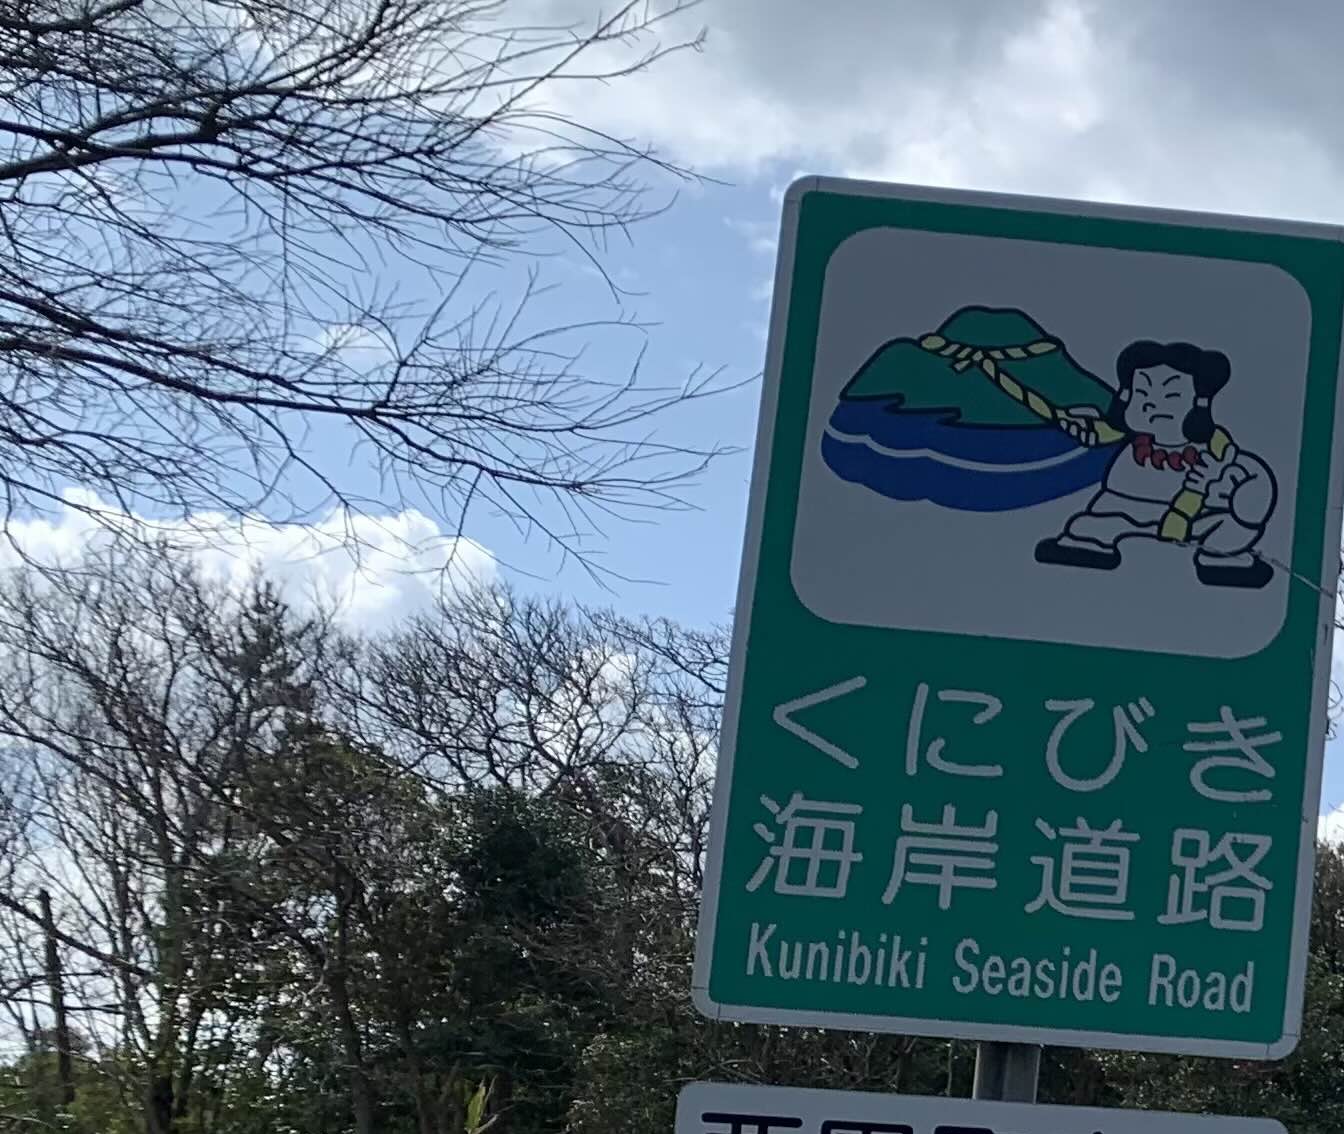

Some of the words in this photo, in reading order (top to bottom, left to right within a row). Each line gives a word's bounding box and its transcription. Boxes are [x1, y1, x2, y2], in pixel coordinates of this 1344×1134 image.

[773, 676, 1283, 802] くにびき
[746, 792, 1274, 931] 海岸道路
[746, 923, 928, 990] Kunibiki
[952, 938, 1122, 1002] Seaside
[1149, 953, 1254, 1013] Road
